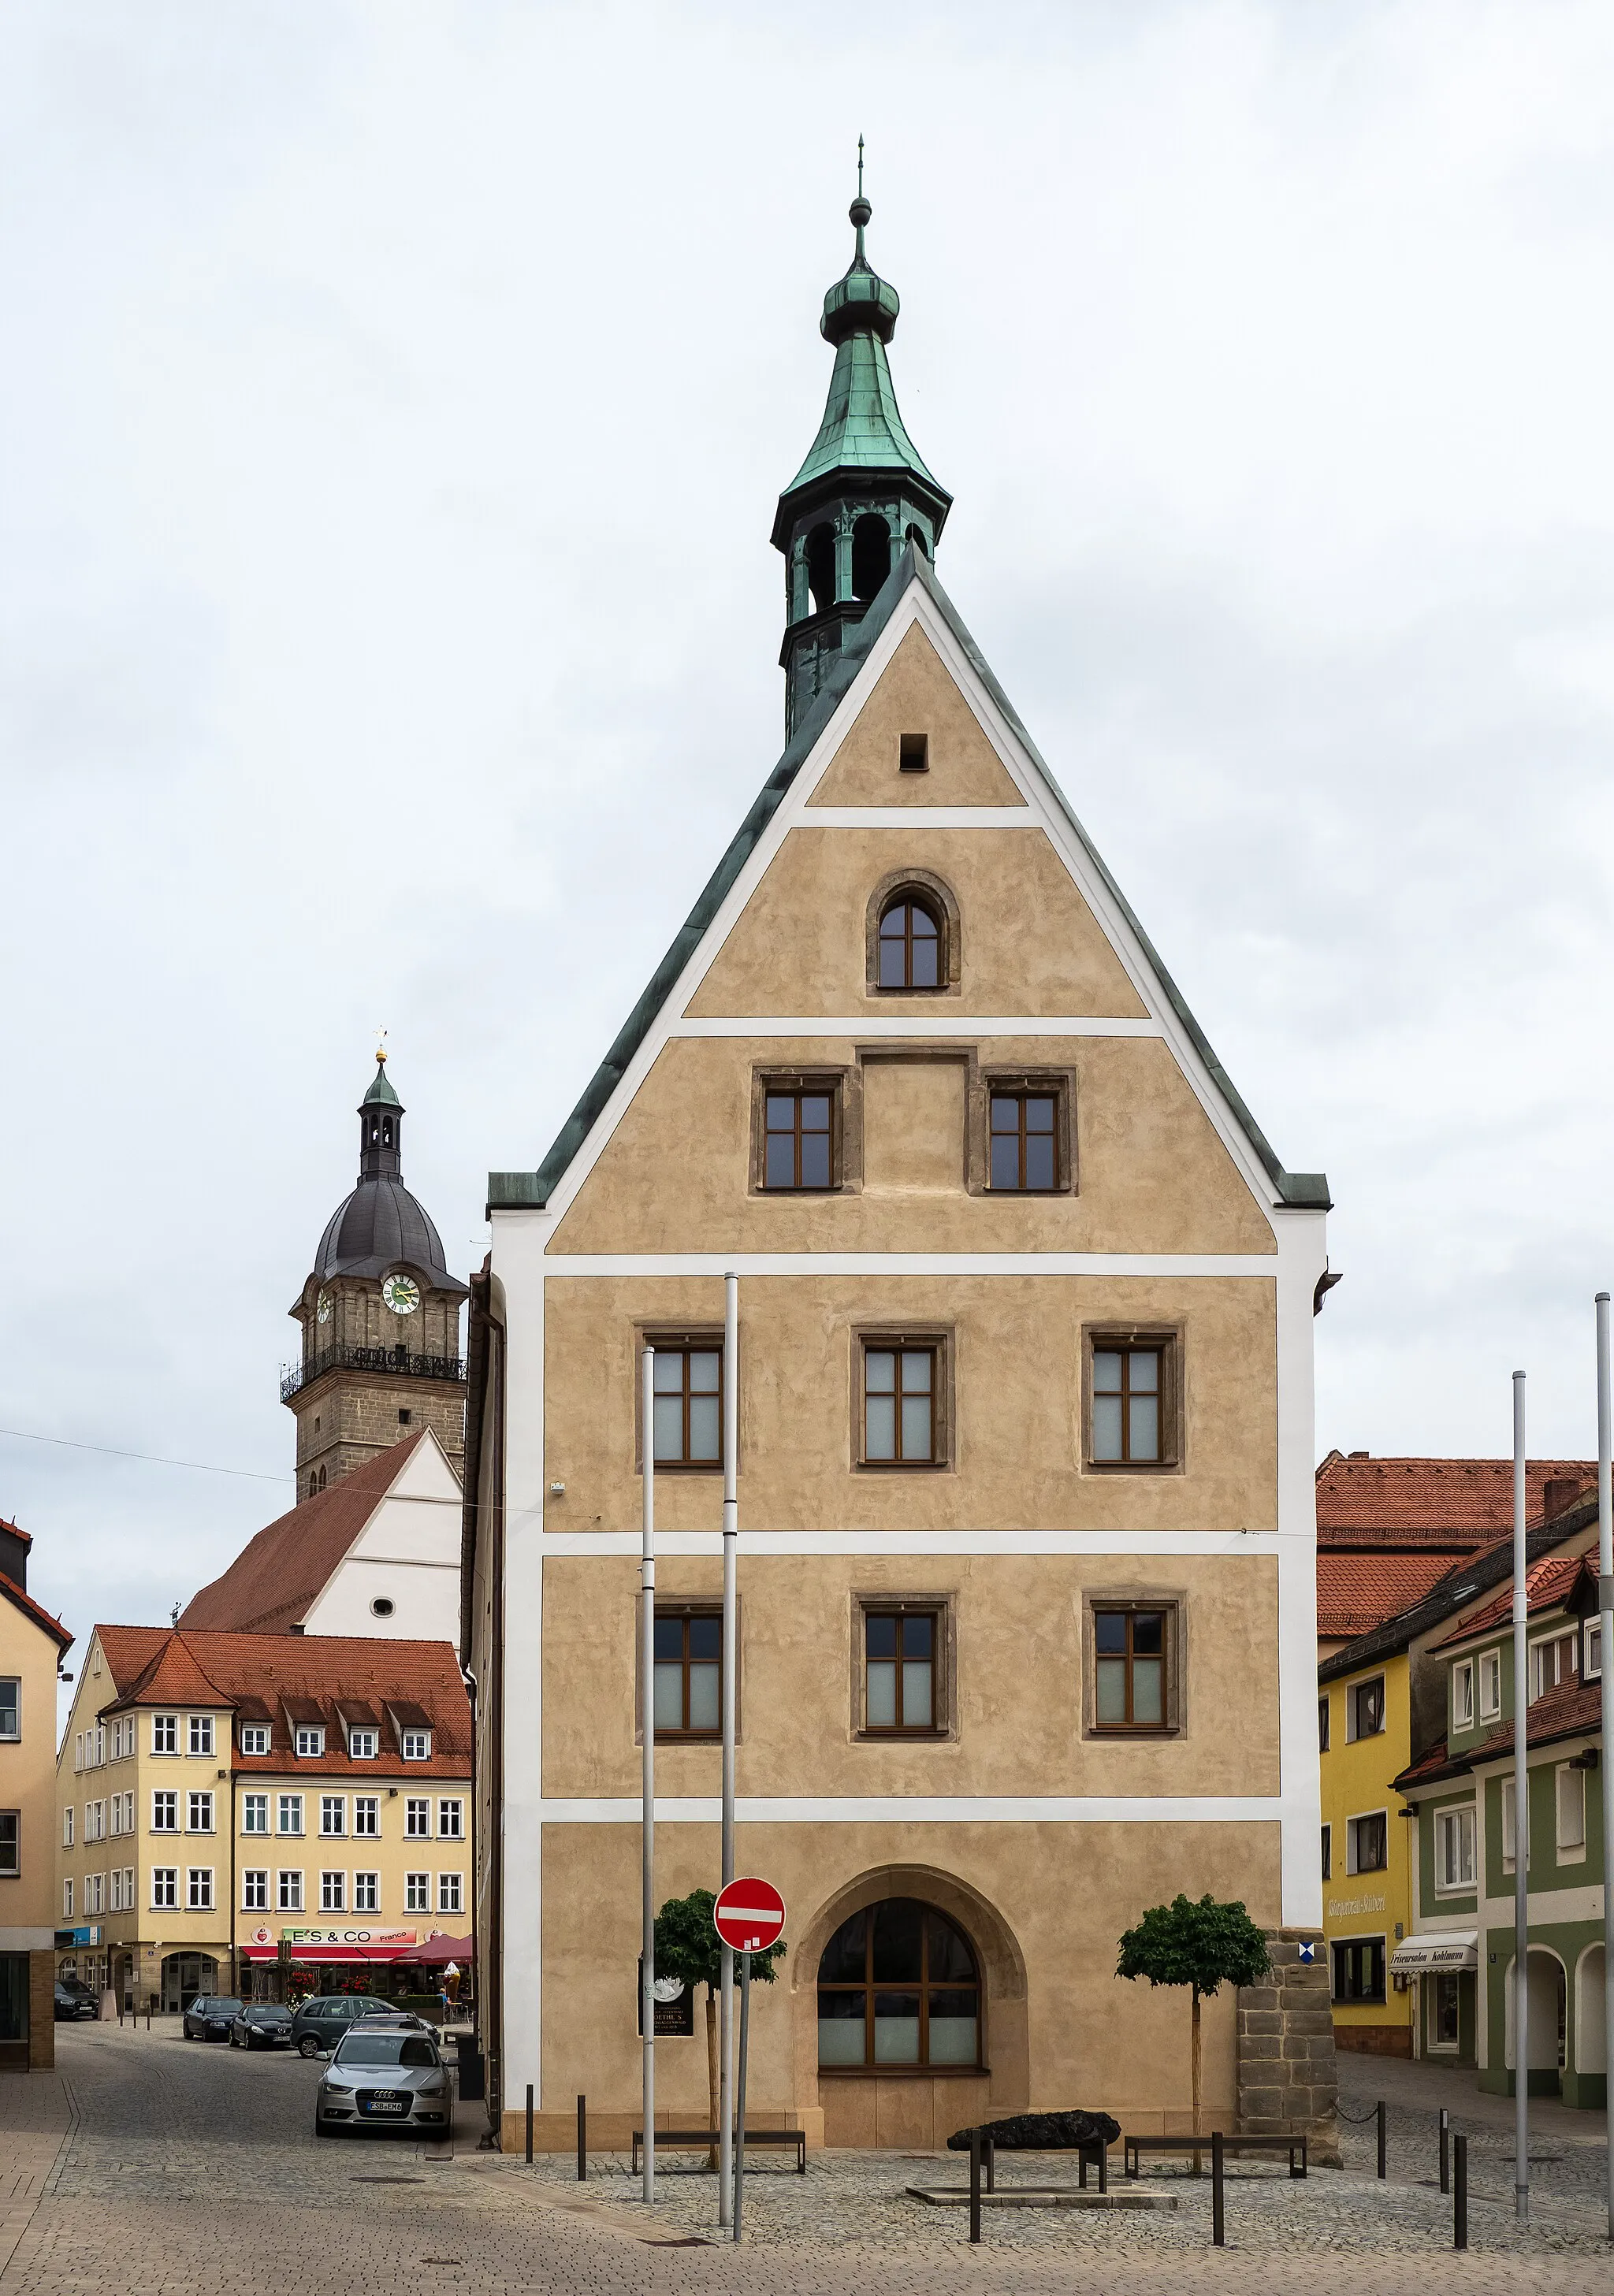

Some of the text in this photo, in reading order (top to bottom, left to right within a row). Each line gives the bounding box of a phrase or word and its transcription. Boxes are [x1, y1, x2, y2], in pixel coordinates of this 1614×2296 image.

[327, 1931, 339, 1942] &
[344, 1930, 371, 1942] CO
[379, 1931, 407, 1941] Franco
[1390, 1950, 1463, 1963] Friseursalon Kohlmann
